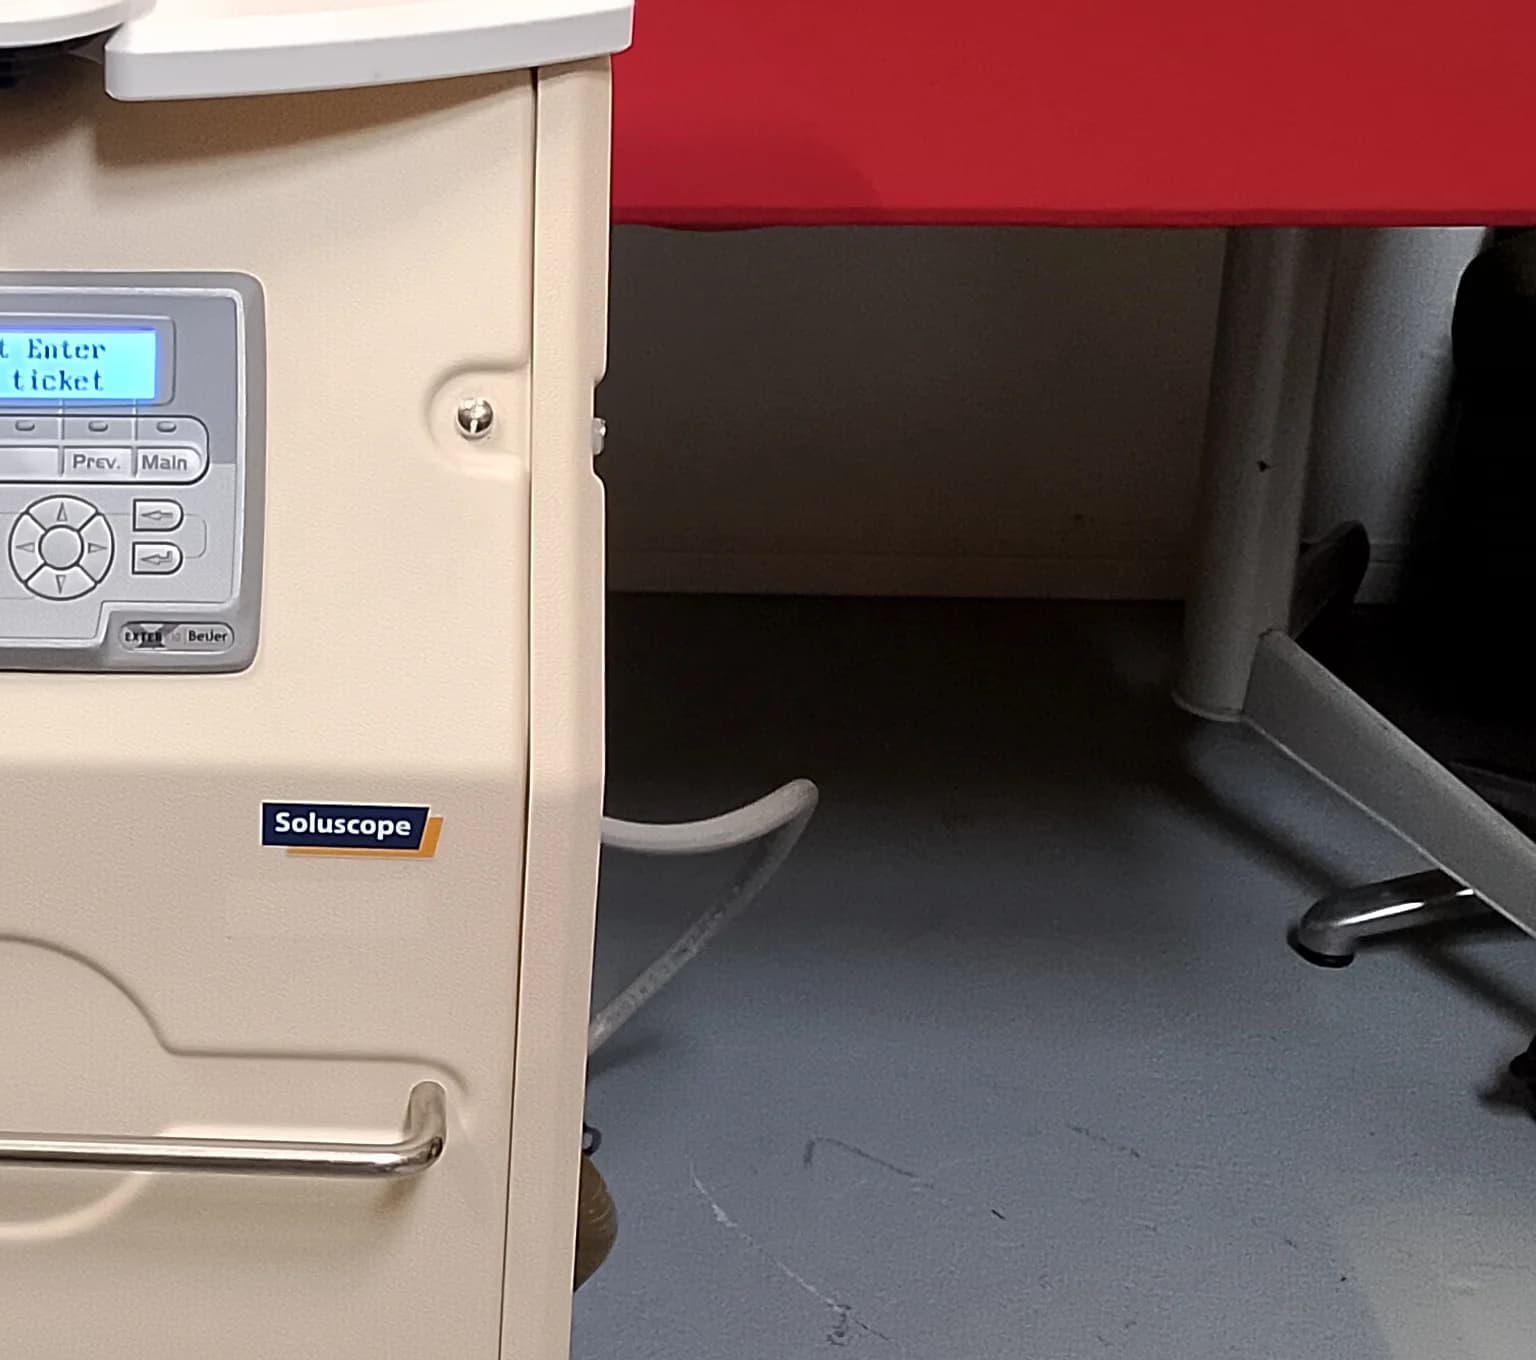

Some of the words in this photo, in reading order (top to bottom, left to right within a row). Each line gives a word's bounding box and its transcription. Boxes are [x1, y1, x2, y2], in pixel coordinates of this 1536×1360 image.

[28, 338, 106, 360] Enter
[14, 369, 104, 391] ticket
[72, 454, 121, 471] Prev.
[141, 455, 188, 471] Main
[274, 812, 412, 840] Soluscope
